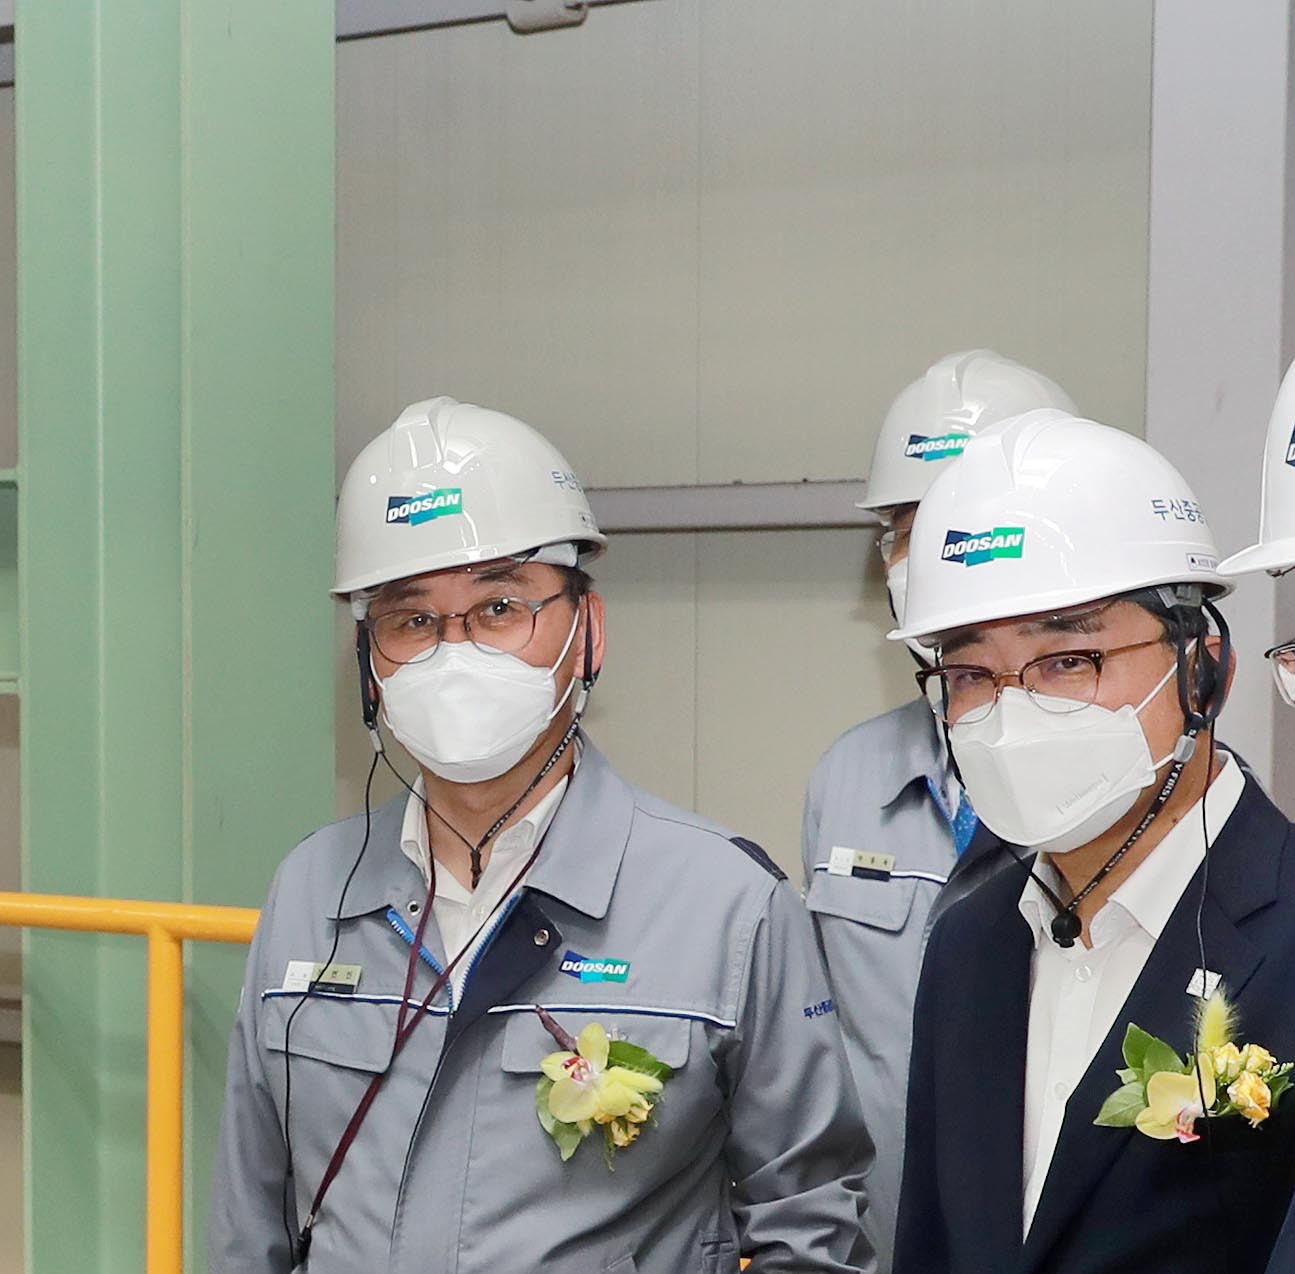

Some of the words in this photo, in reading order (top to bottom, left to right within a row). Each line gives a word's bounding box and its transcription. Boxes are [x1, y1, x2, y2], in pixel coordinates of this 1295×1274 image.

[905, 438, 968, 456] DOOSAN
[387, 493, 461, 522] DOOSAN
[943, 533, 1023, 559] DOOSAN
[561, 960, 628, 975] DOOSAN
